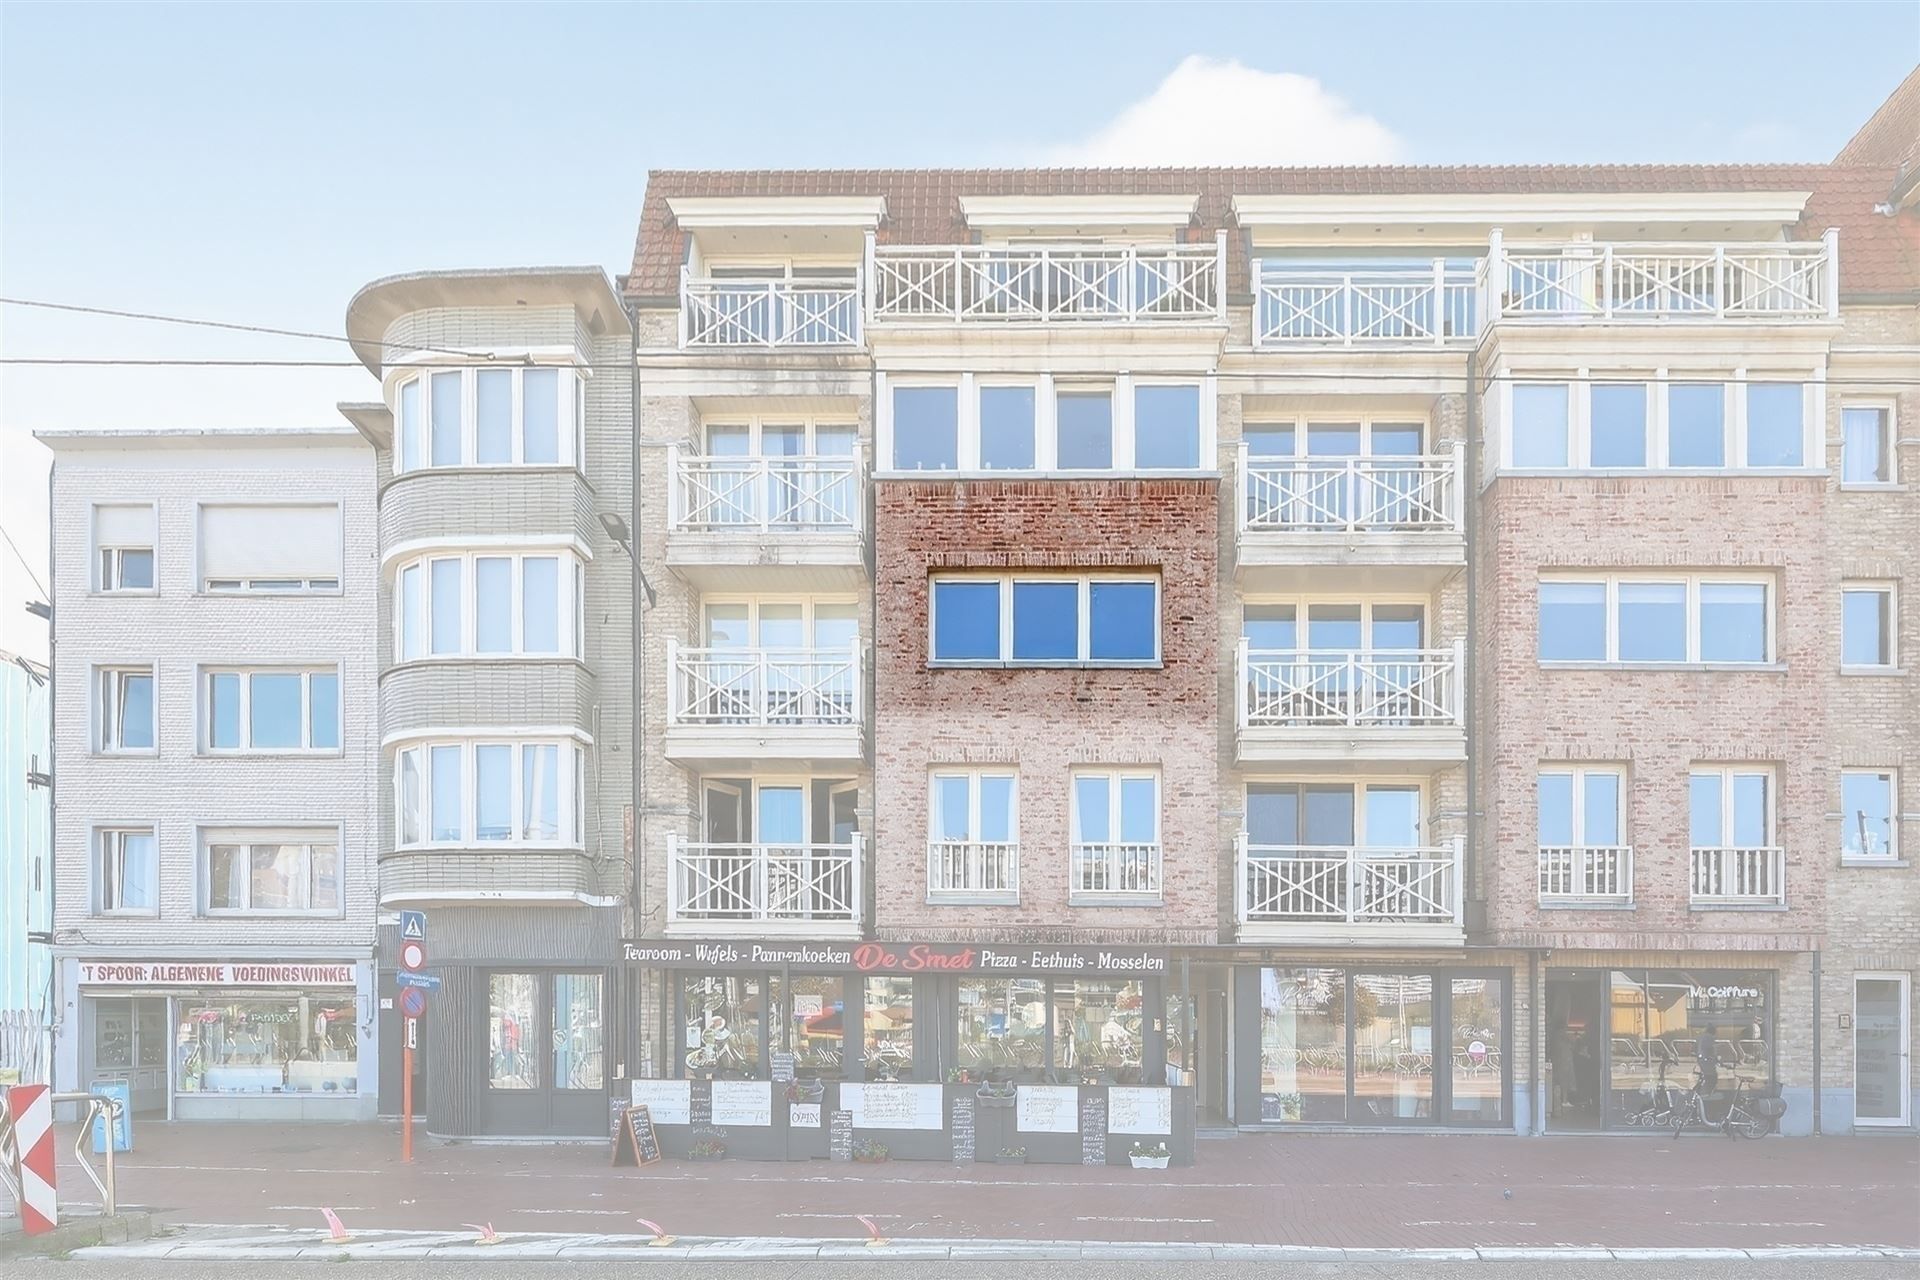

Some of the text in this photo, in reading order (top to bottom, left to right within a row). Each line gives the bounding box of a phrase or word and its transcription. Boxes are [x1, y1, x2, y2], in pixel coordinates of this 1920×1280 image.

[623, 943, 681, 961] Tearoom
[751, 945, 850, 963] Pannenkoeken
[853, 943, 976, 970] De Smet
[980, 949, 1018, 967] Pizza
[1031, 951, 1085, 969] Eethuis
[1097, 952, 1164, 970] Mosselen
[82, 965, 353, 982] 'T SPOOR: ALGEMENE VOEDINGSWINKEL
[1707, 985, 1758, 998] Coiffure
